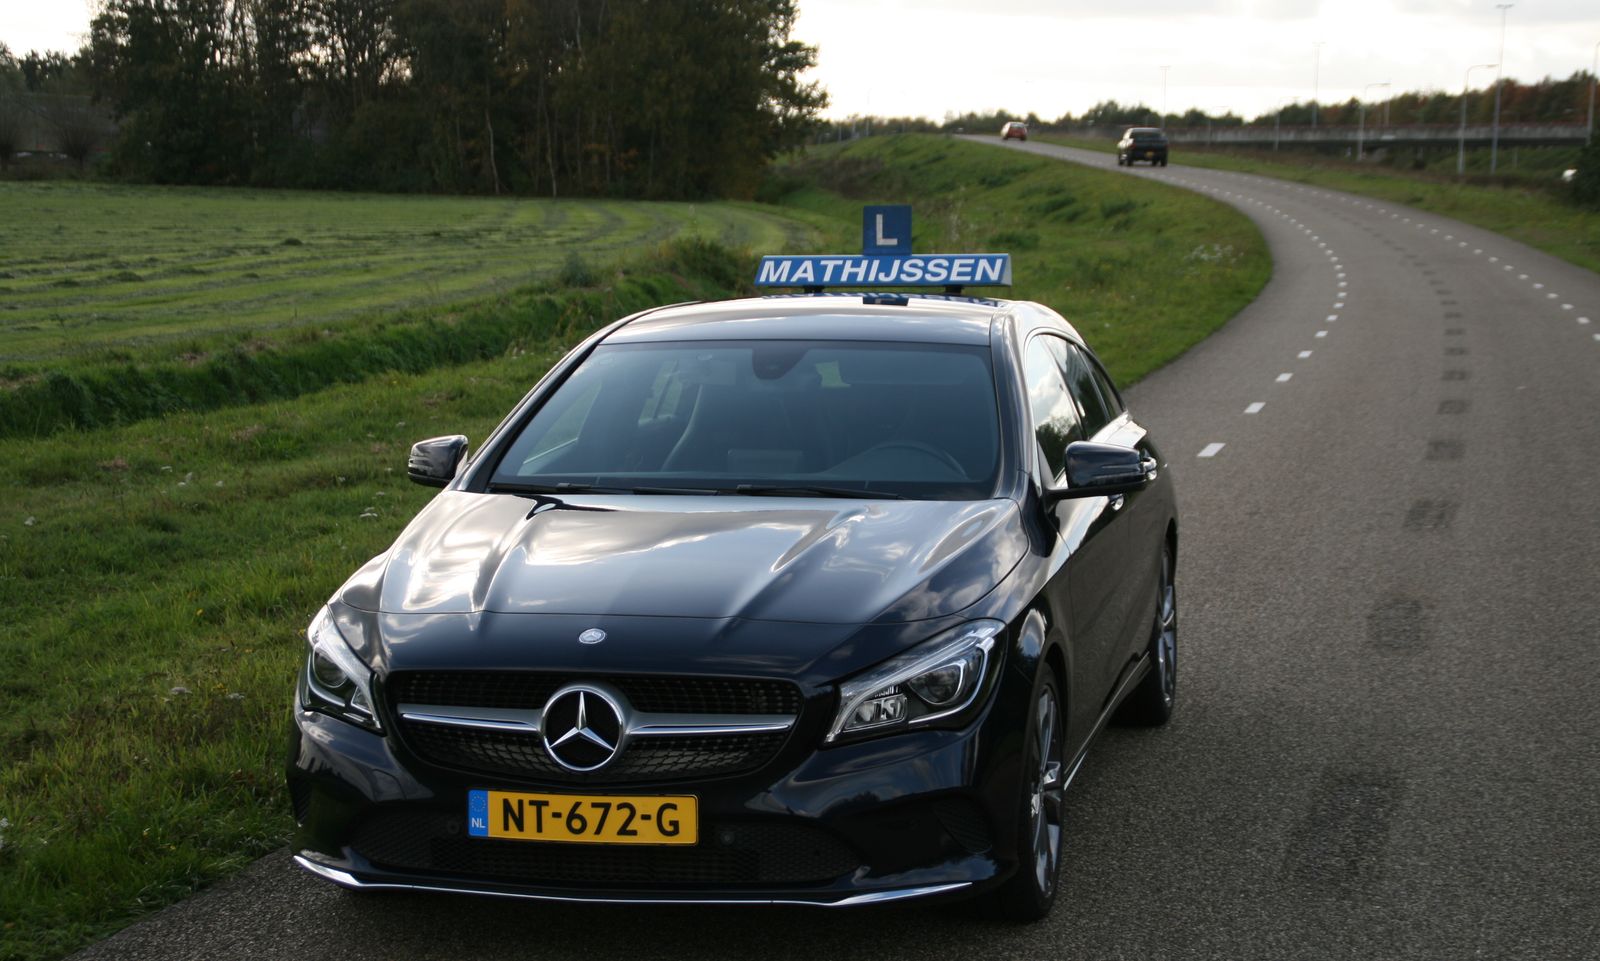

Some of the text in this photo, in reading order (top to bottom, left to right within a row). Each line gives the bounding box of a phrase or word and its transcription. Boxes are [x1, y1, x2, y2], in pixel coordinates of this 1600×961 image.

[876, 214, 898, 246] L
[759, 258, 1002, 282] MATHIJSSEN
[471, 817, 486, 828] NL
[502, 798, 680, 837] NT-672-G
